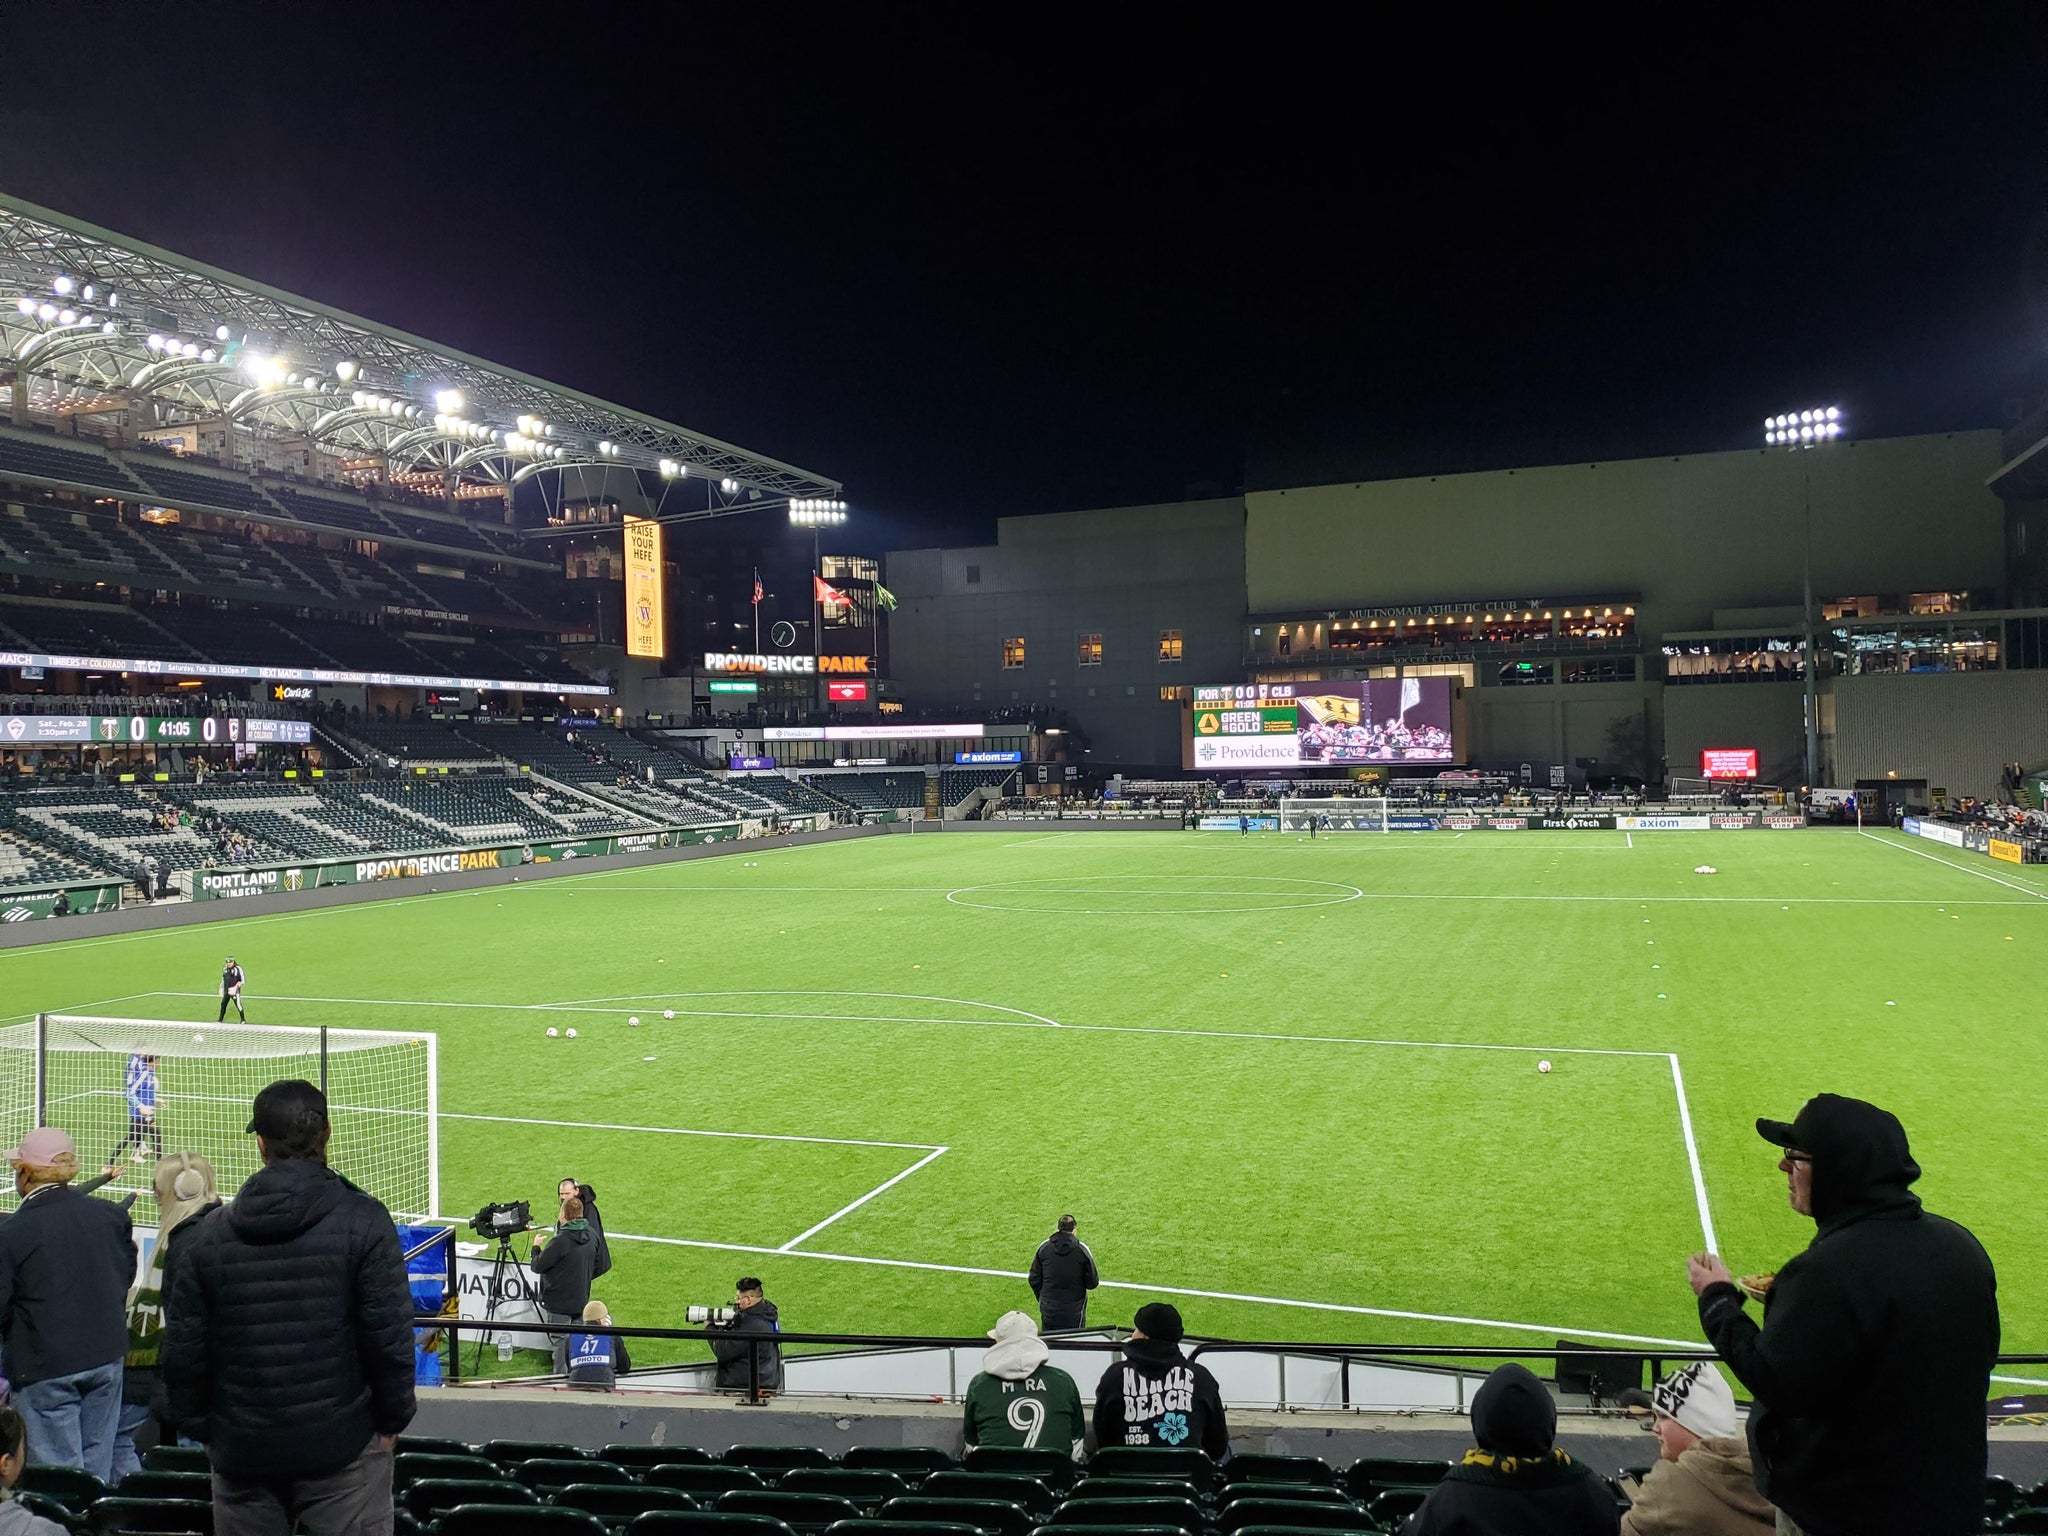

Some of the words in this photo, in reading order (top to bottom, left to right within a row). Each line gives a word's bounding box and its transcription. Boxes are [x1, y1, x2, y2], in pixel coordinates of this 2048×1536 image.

[631, 524, 653, 538] RAISE
[631, 536, 654, 550] YOUR
[633, 549, 652, 561] HEFE
[1350, 606, 1422, 619] MULTNOMAH
[1426, 602, 1480, 615] ATHLETIC
[1485, 601, 1517, 611] CLUB
[638, 635, 652, 645] HEFE
[48, 656, 80, 667] TIMBERS
[89, 659, 126, 669] COLORADO
[704, 653, 814, 672] PROVIDENCE
[818, 656, 870, 673] PARK
[1393, 653, 1428, 664] SOCCER
[1457, 654, 1477, 662] USA
[260, 668, 277, 678] NEXT
[278, 670, 301, 679] MATCH
[284, 687, 302, 698] Carl's
[1198, 689, 1219, 700] POR
[1235, 686, 1244, 699] 0
[1246, 686, 1255, 699] 0
[1271, 686, 1292, 698] CLB
[1221, 712, 1260, 723] GREEN
[39, 729, 68, 737] 1:30pm
[130, 716, 145, 740] 0
[158, 721, 190, 736] 41:05
[203, 717, 216, 741] 0
[1229, 722, 1260, 732] GOLD
[1221, 744, 1294, 759] Providence
[743, 759, 760, 768] xfinity
[972, 753, 1000, 763] axiom
[1543, 819, 1565, 828] First
[1578, 820, 1600, 828] Tech
[1639, 818, 1679, 828] axiom
[617, 834, 657, 847] PORTLAND
[356, 854, 459, 881] PROVIDENCE
[459, 850, 498, 870] PARK
[203, 871, 277, 890] PORTLAND
[3, 896, 16, 904] OF
[457, 1273, 539, 1301] MATON
[581, 1340, 599, 1354] 47
[577, 1356, 603, 1364] PHOTO
[1002, 1379, 1047, 1394] MRA
[1123, 1390, 1193, 1423] BEACH
[1007, 1396, 1045, 1449] 9
[1129, 1426, 1143, 1434] EST.
[1125, 1434, 1150, 1445] 1938
